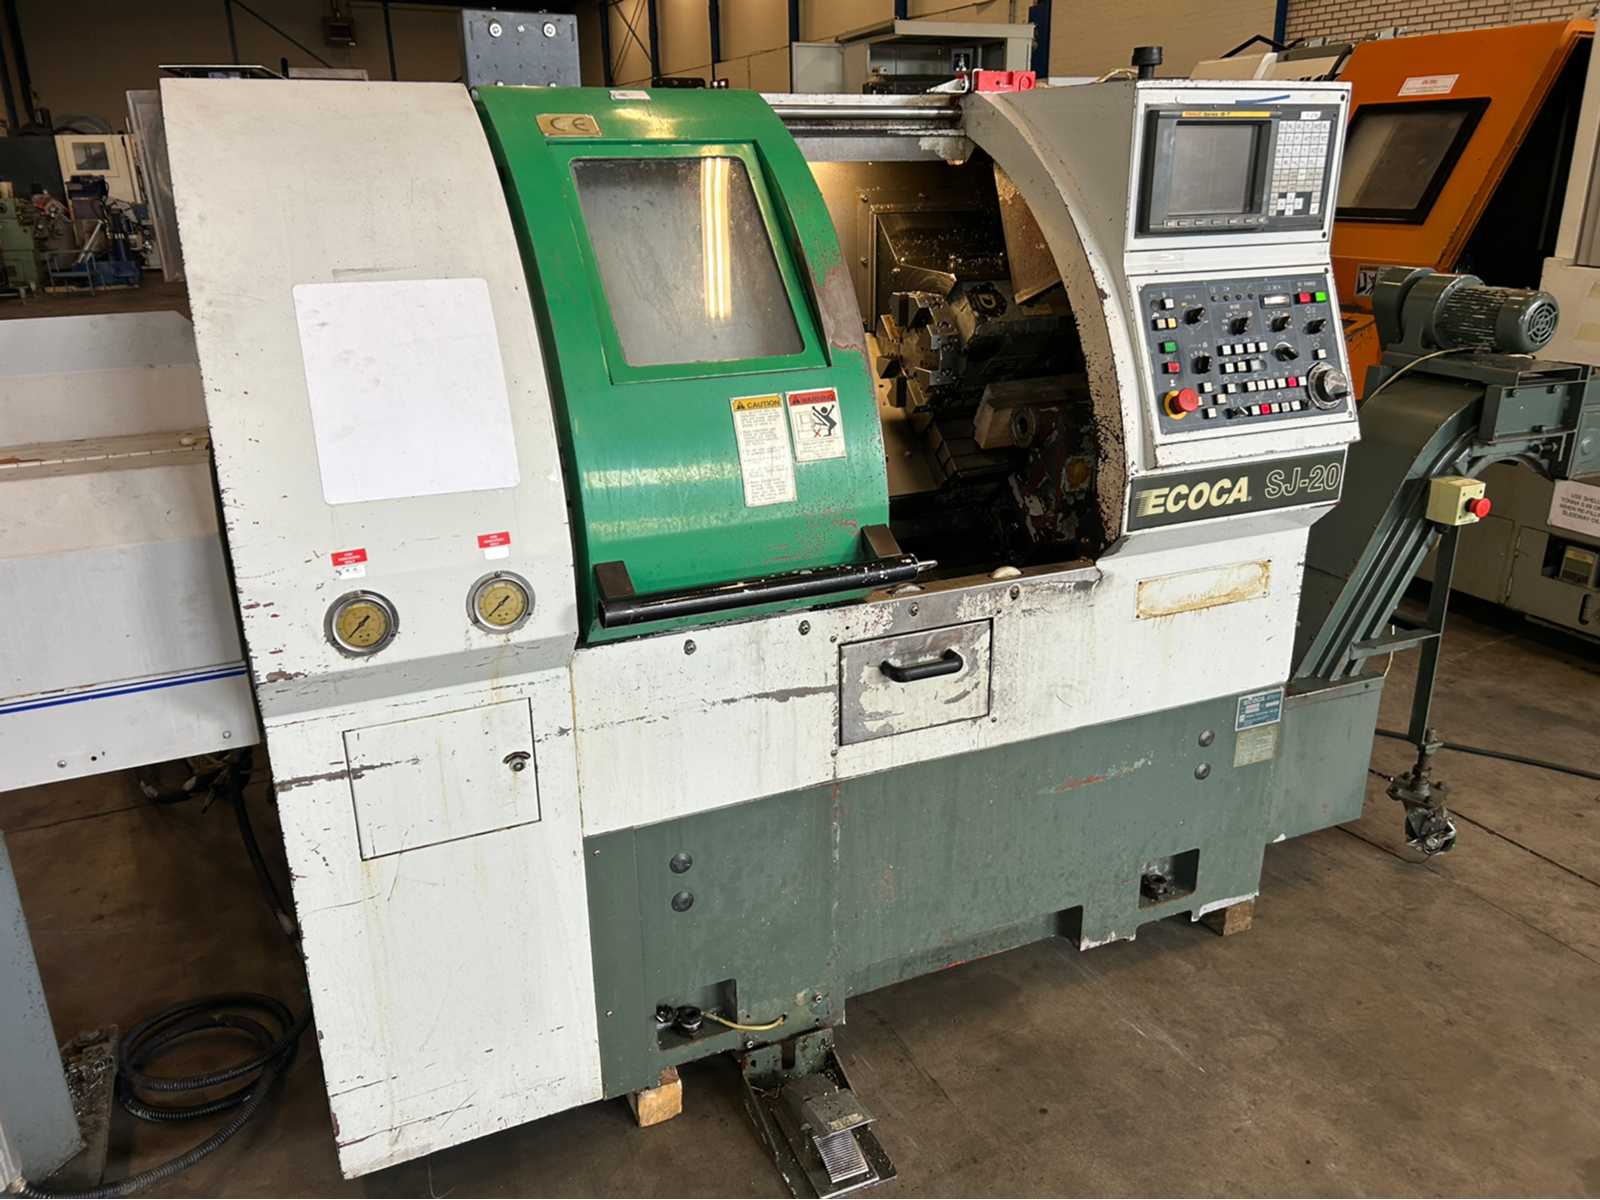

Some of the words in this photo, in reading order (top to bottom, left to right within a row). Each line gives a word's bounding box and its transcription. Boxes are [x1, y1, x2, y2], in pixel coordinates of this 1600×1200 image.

[746, 399, 780, 410] CAUTION
[1137, 476, 1249, 517] ECOCA
[1264, 462, 1342, 499] SJ-20
